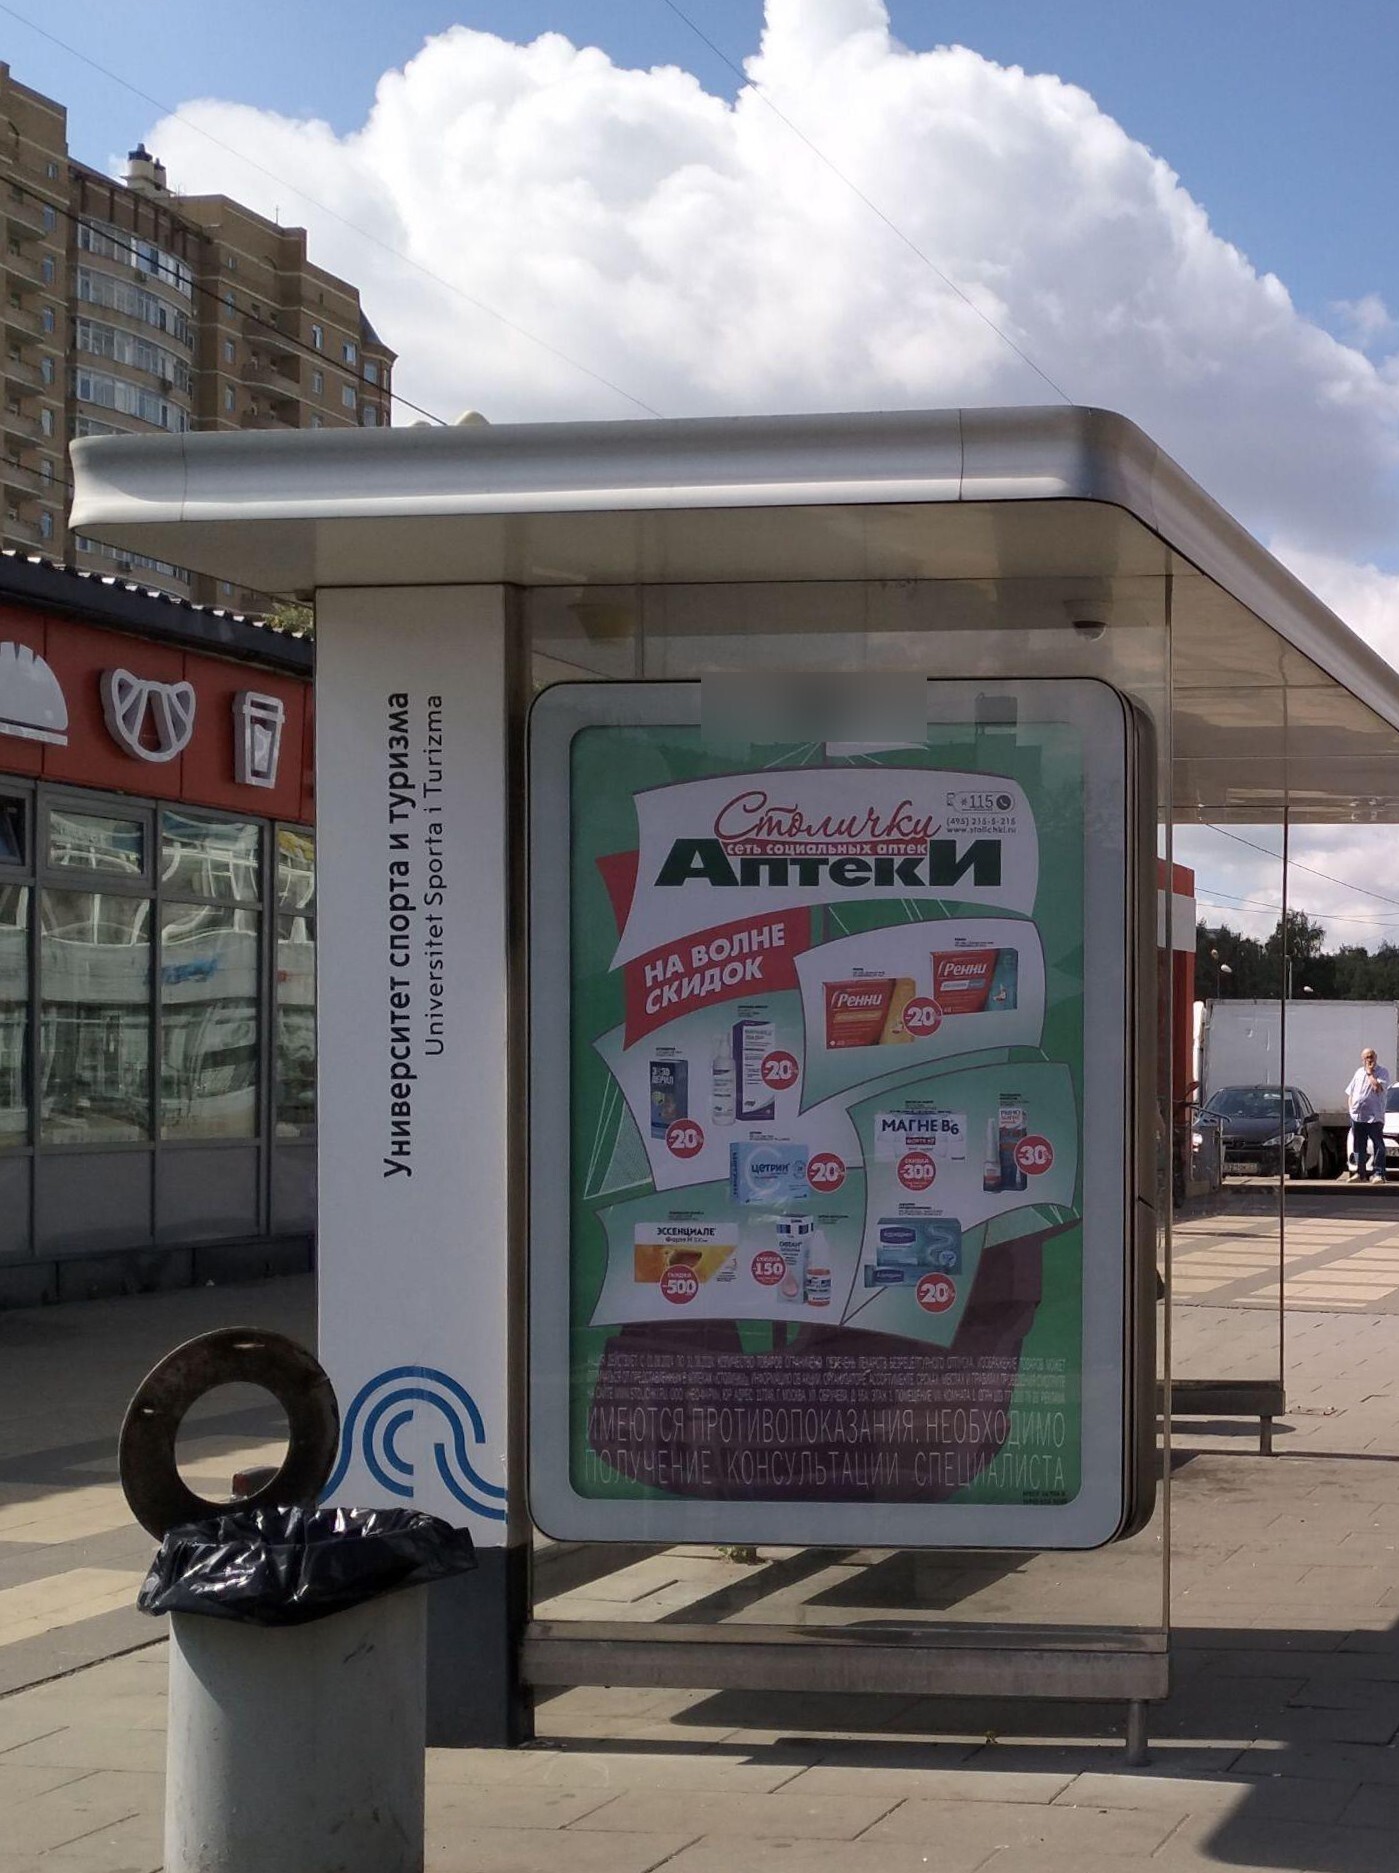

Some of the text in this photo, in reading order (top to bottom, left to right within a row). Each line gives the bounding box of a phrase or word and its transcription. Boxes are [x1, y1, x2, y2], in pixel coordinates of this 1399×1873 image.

[424, 696, 443, 798] Turizma
[714, 791, 941, 841] Столички
[424, 823, 447, 907] Sporta
[727, 843, 927, 857] сеть социальных аптек
[383, 692, 416, 1178] Университет спорта и туризма
[644, 922, 785, 988] НА ВОЛНЕ
[424, 915, 444, 1056] Universitet
[645, 956, 764, 1015] СКИДОК
[881, 1118, 938, 1133] МАГНЕ
[586, 1407, 1065, 1448] ИМЕЮТСЯ ПРОТИВОПОКАЗАНИЯ. НЕОБХОДИМО
[585, 1450, 1065, 1490] ПОЛУЧЕНИЕ КОНСУЛЬТАЦИИ СПЕЦИАЛИСТА
